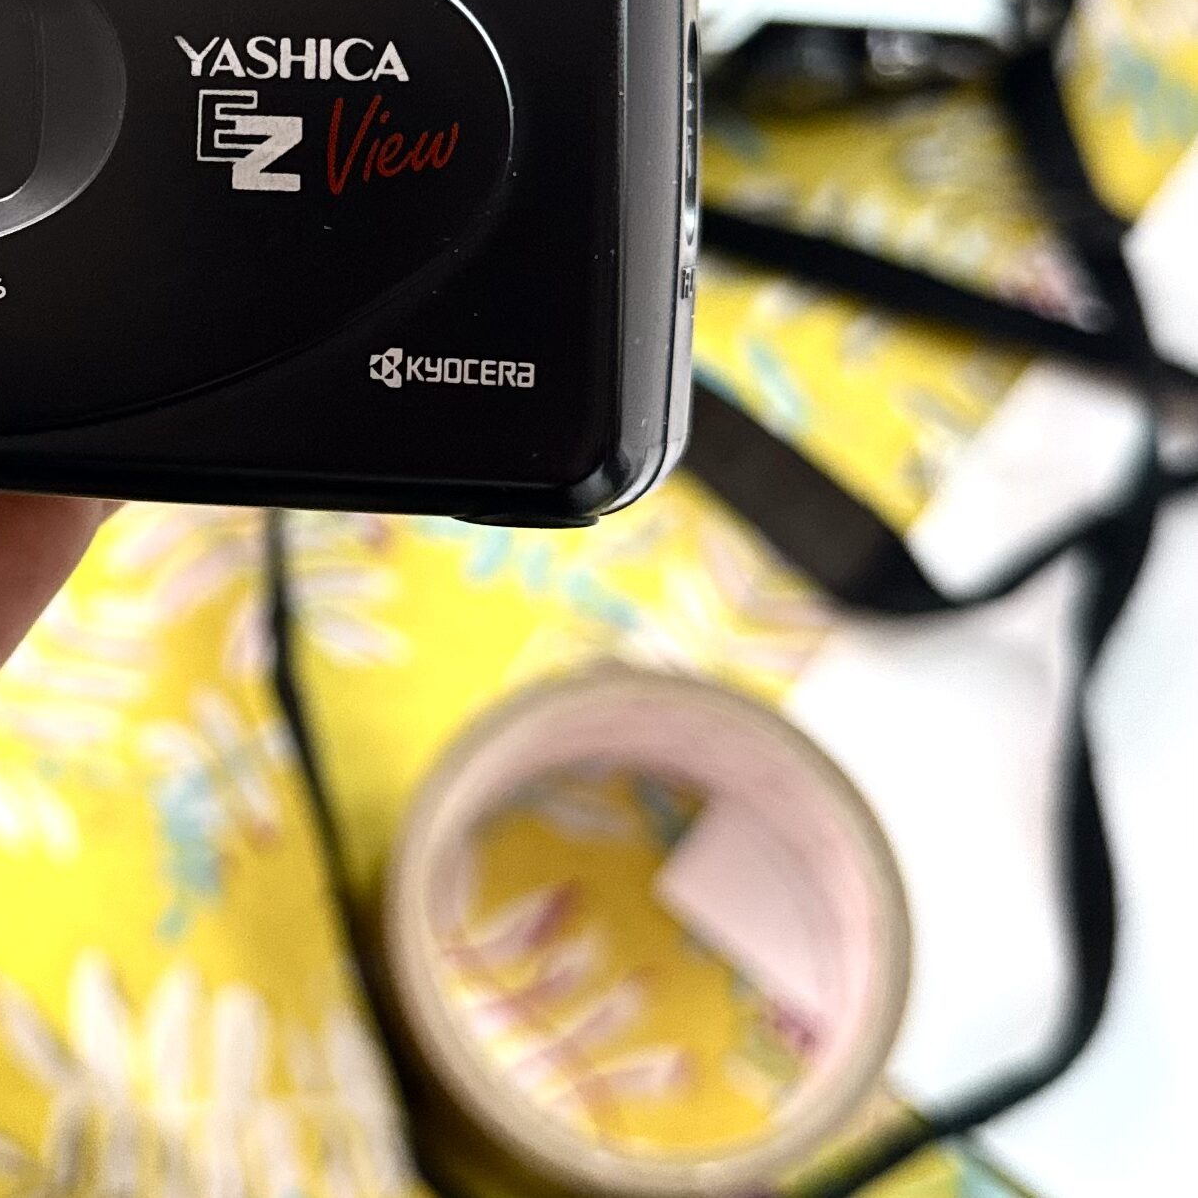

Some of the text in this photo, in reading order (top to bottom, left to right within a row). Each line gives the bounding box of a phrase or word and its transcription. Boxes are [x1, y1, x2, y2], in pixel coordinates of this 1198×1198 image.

[174, 35, 409, 82] YASHICA
[196, 89, 460, 196] EZ View
[406, 355, 535, 388] KYOCERA
